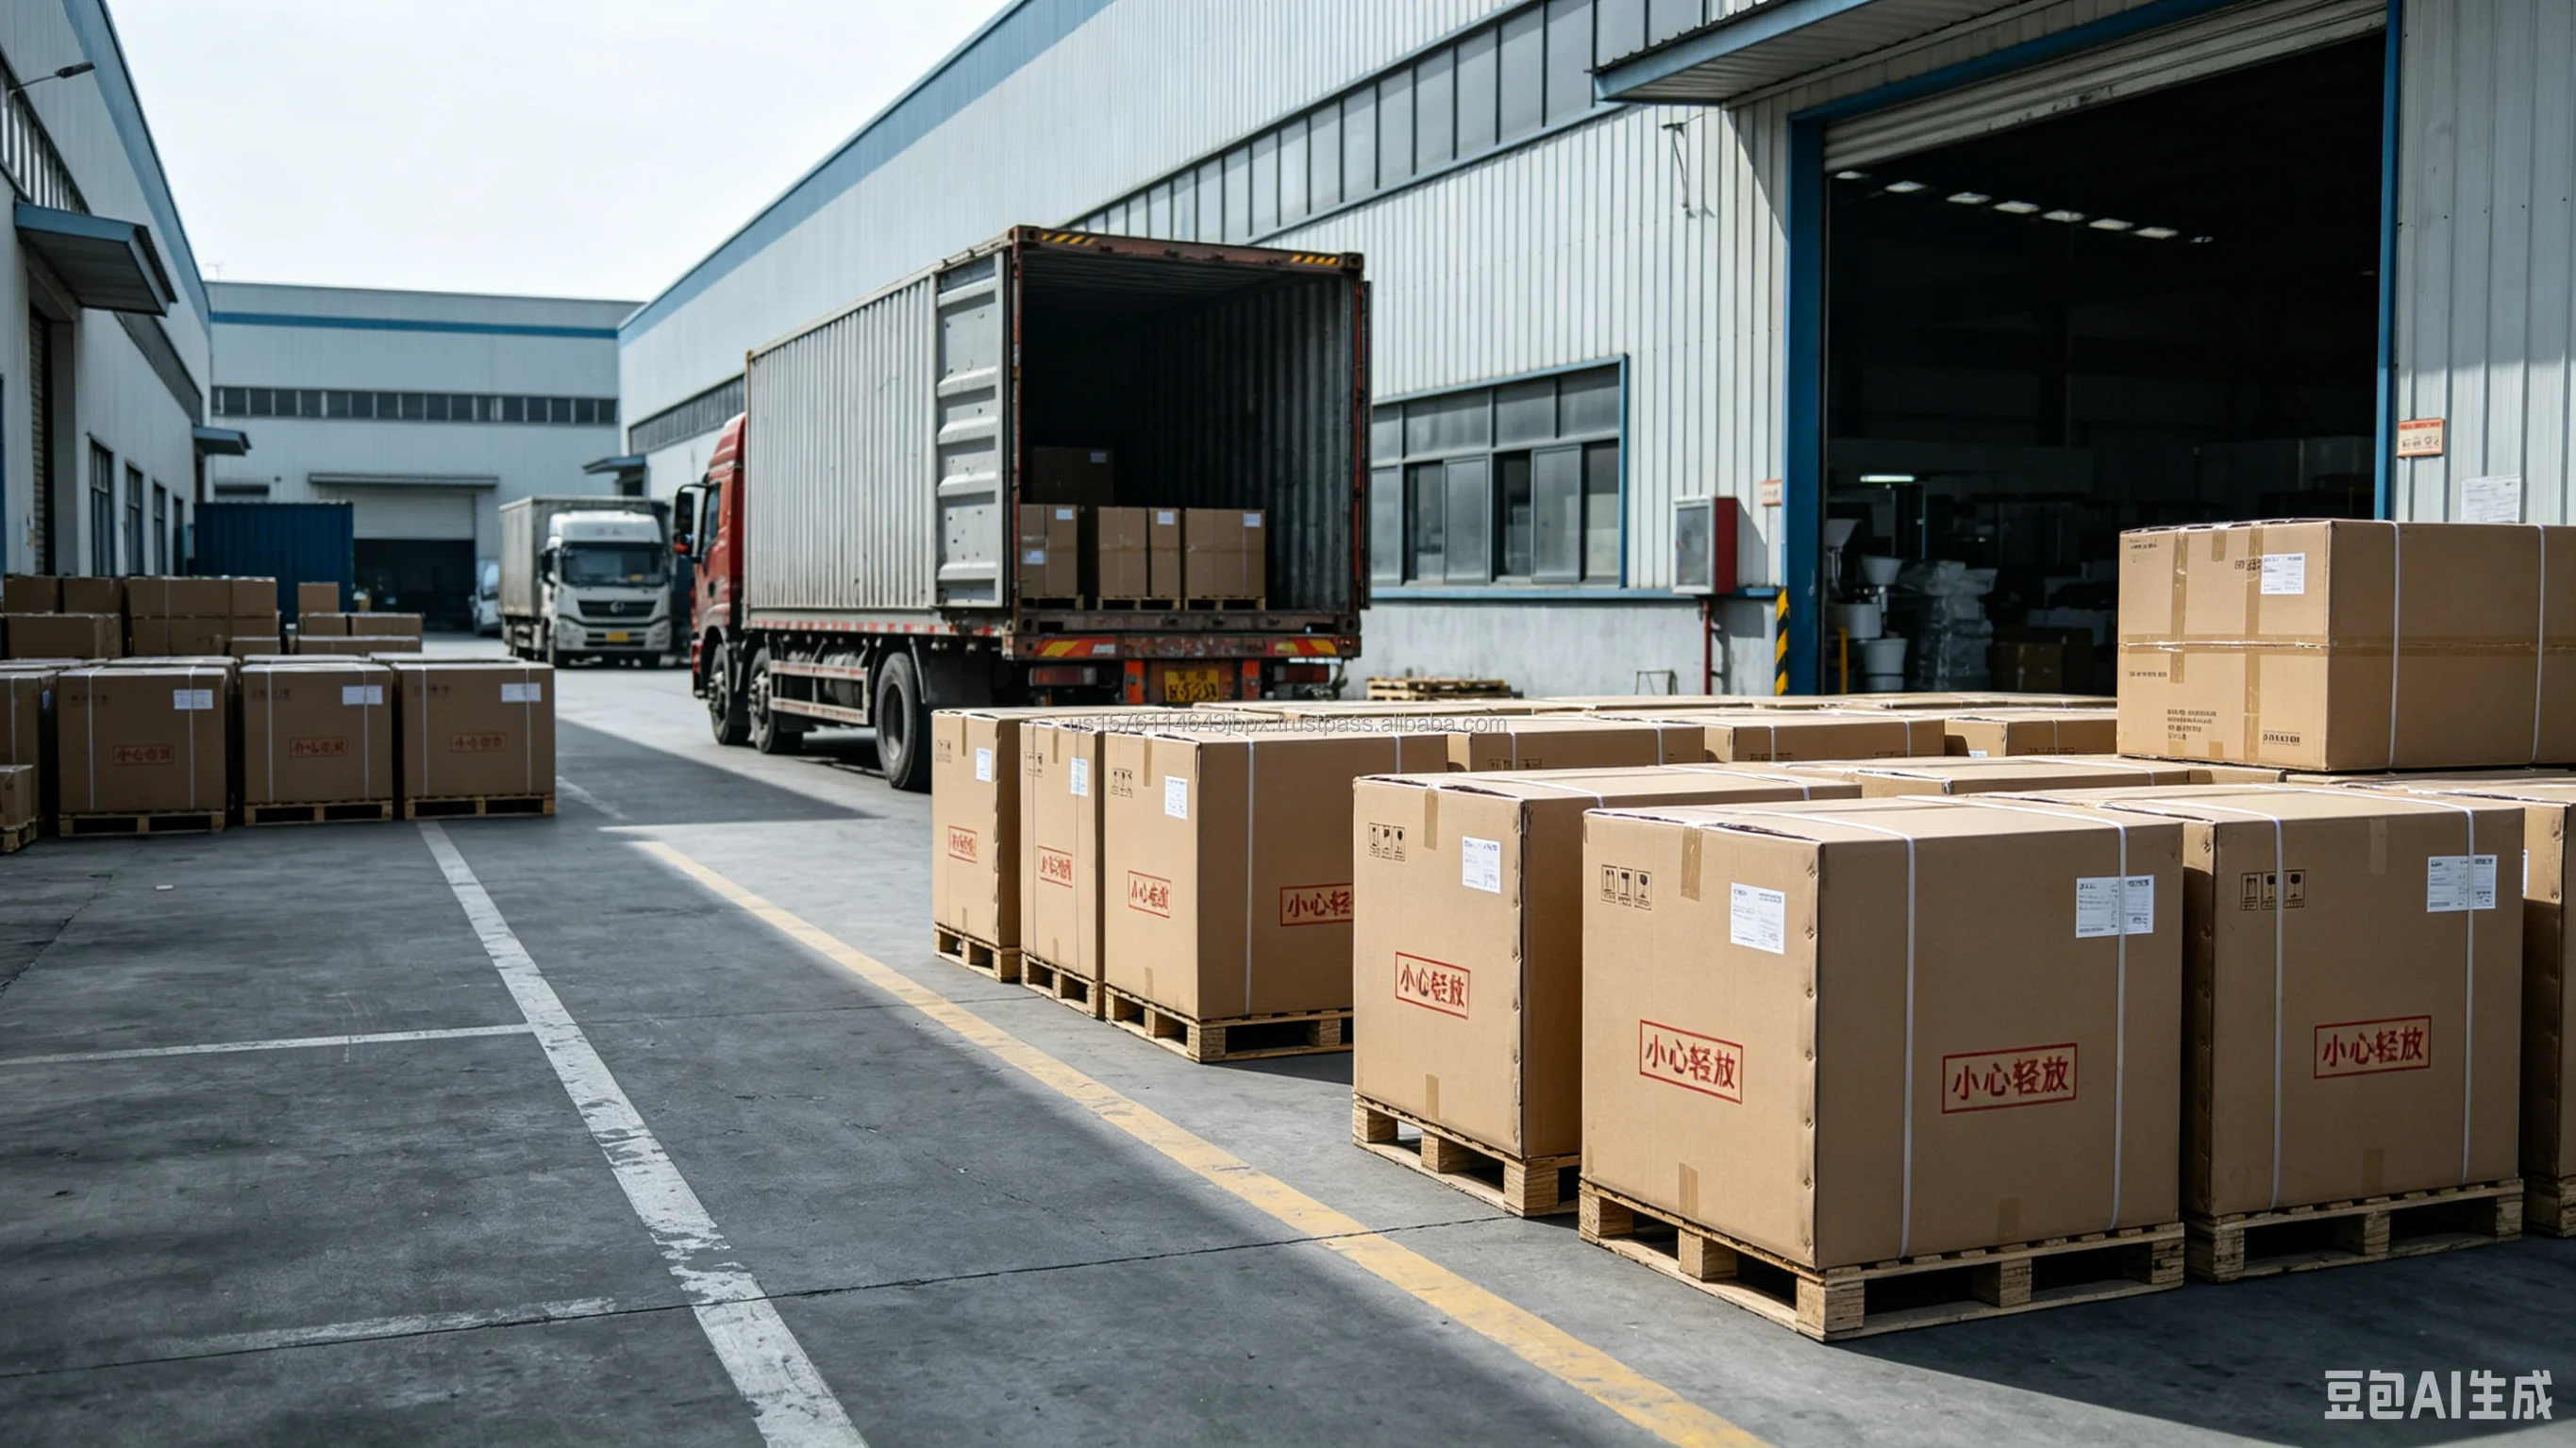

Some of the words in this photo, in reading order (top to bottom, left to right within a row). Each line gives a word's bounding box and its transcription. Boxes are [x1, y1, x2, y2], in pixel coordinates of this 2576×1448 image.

[1646, 1034, 1735, 1090] 小心轻放
[2322, 1025, 2424, 1068] 小心轻放
[1952, 1056, 2069, 1100] 小心轻放
